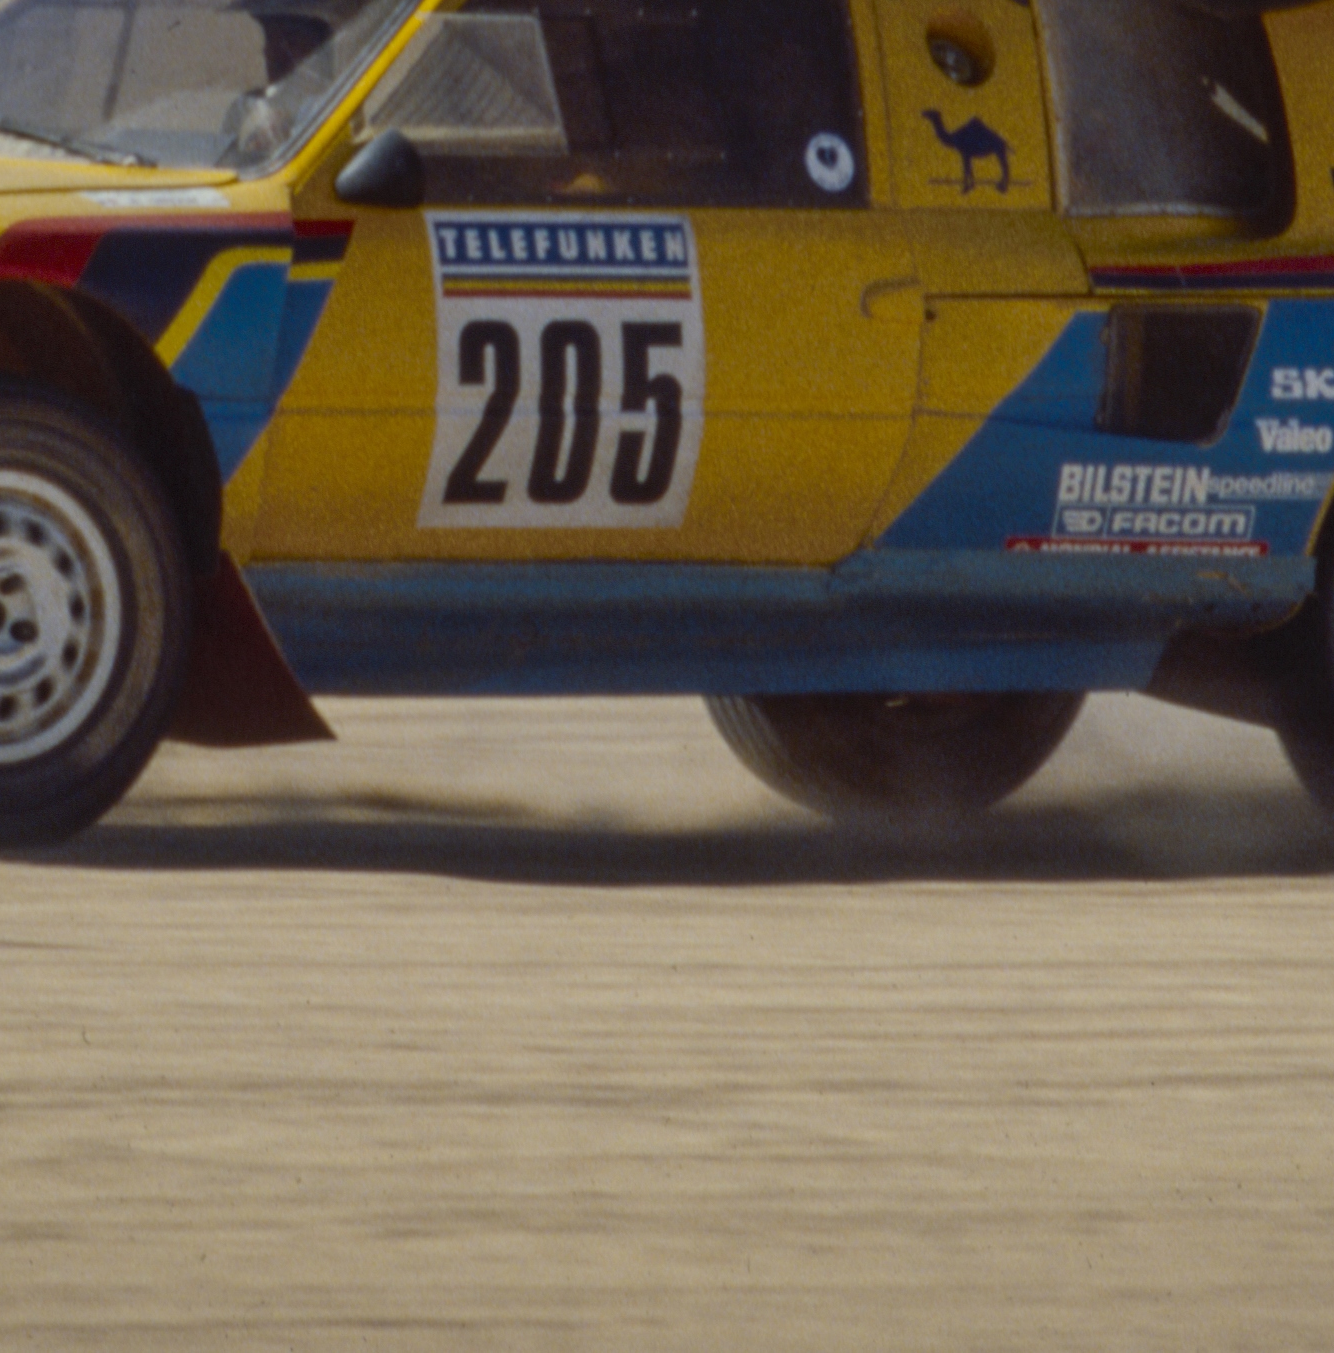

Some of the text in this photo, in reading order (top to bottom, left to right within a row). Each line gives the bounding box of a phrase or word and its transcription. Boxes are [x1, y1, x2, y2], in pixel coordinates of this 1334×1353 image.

[439, 227, 686, 262] TELEFUNKEN
[442, 319, 683, 504] 205
[1256, 418, 1334, 454] Valeo
[1059, 463, 1211, 505] BILSTEIN
[1111, 510, 1245, 535] FACOM
